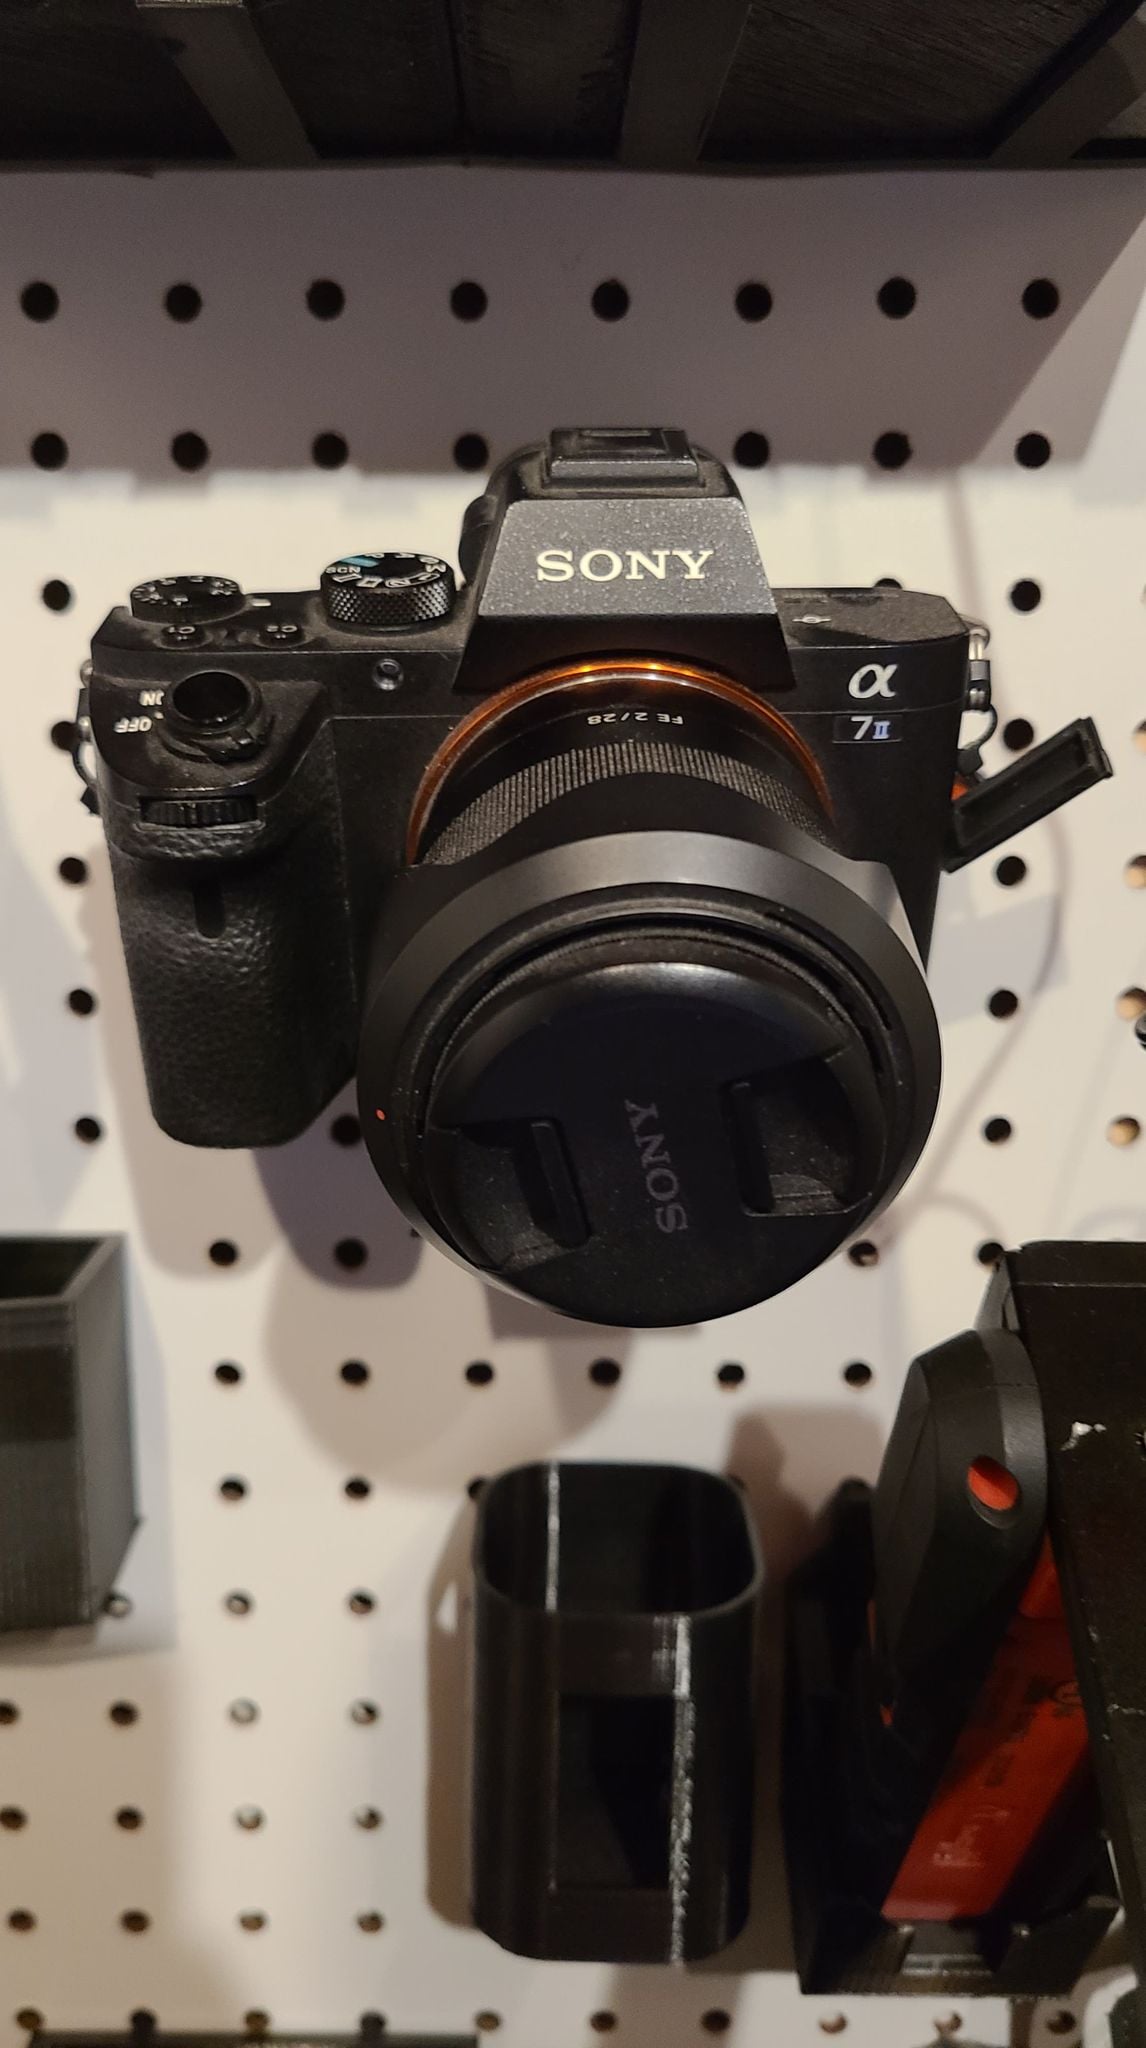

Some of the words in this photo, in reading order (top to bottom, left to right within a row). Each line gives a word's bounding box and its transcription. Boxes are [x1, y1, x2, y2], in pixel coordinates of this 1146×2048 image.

[536, 549, 714, 582] SONY
[113, 715, 152, 734] OFF
[587, 711, 649, 725] 2/28
[656, 713, 684, 725] FE
[624, 1099, 688, 1234] SONY
